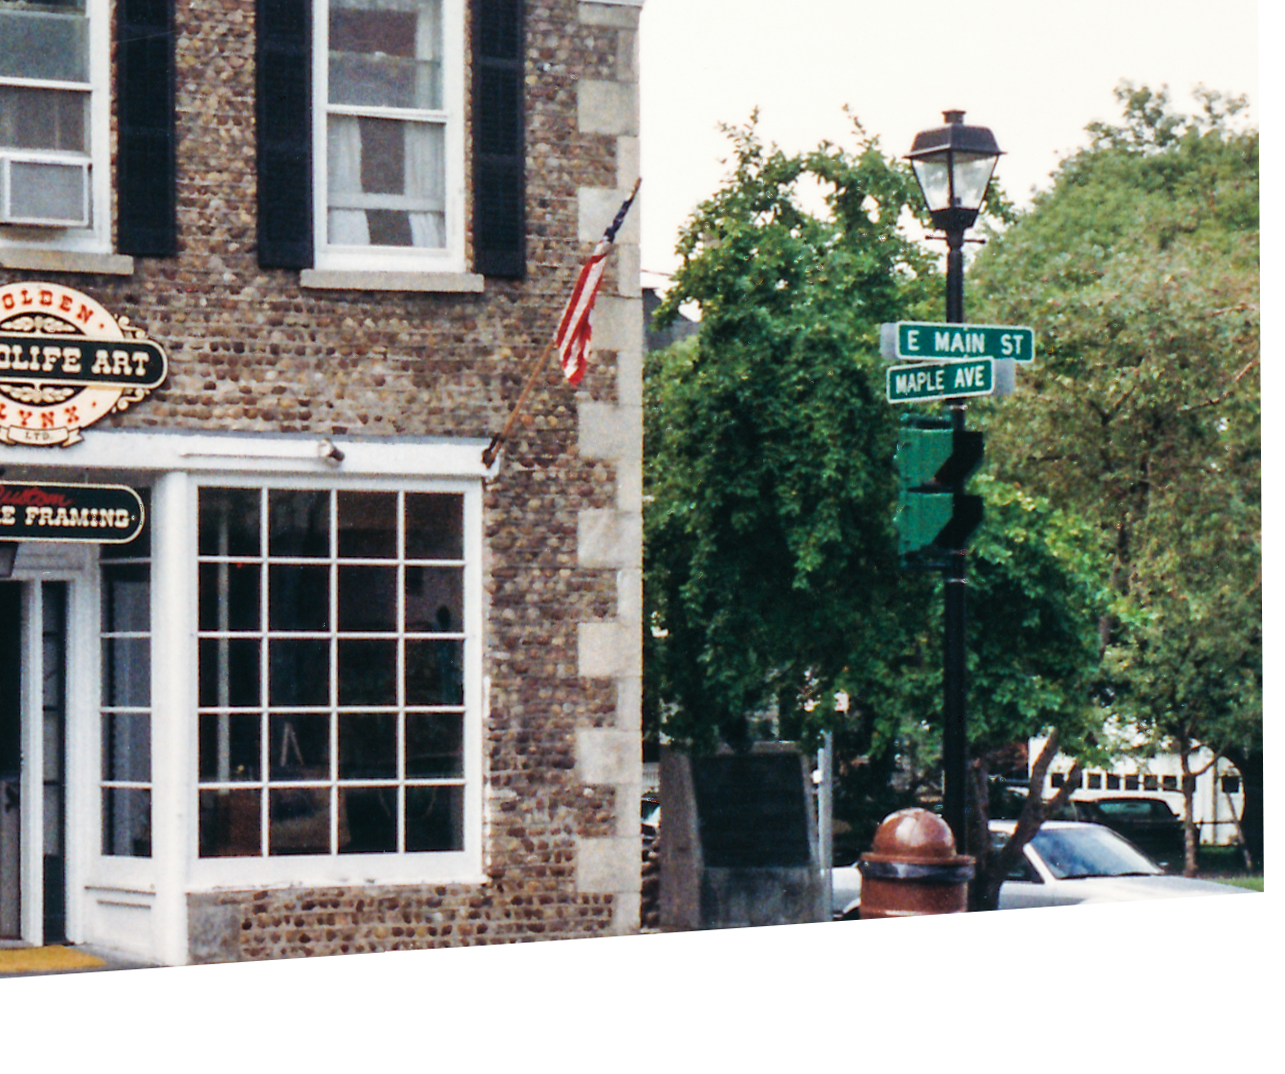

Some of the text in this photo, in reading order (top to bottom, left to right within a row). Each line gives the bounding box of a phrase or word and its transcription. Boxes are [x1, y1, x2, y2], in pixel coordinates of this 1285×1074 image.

[907, 330, 1024, 356] E MAIN ST
[91, 349, 150, 376] ART
[895, 365, 985, 395] MAPLE AVE
[25, 506, 130, 528] FRAMING
